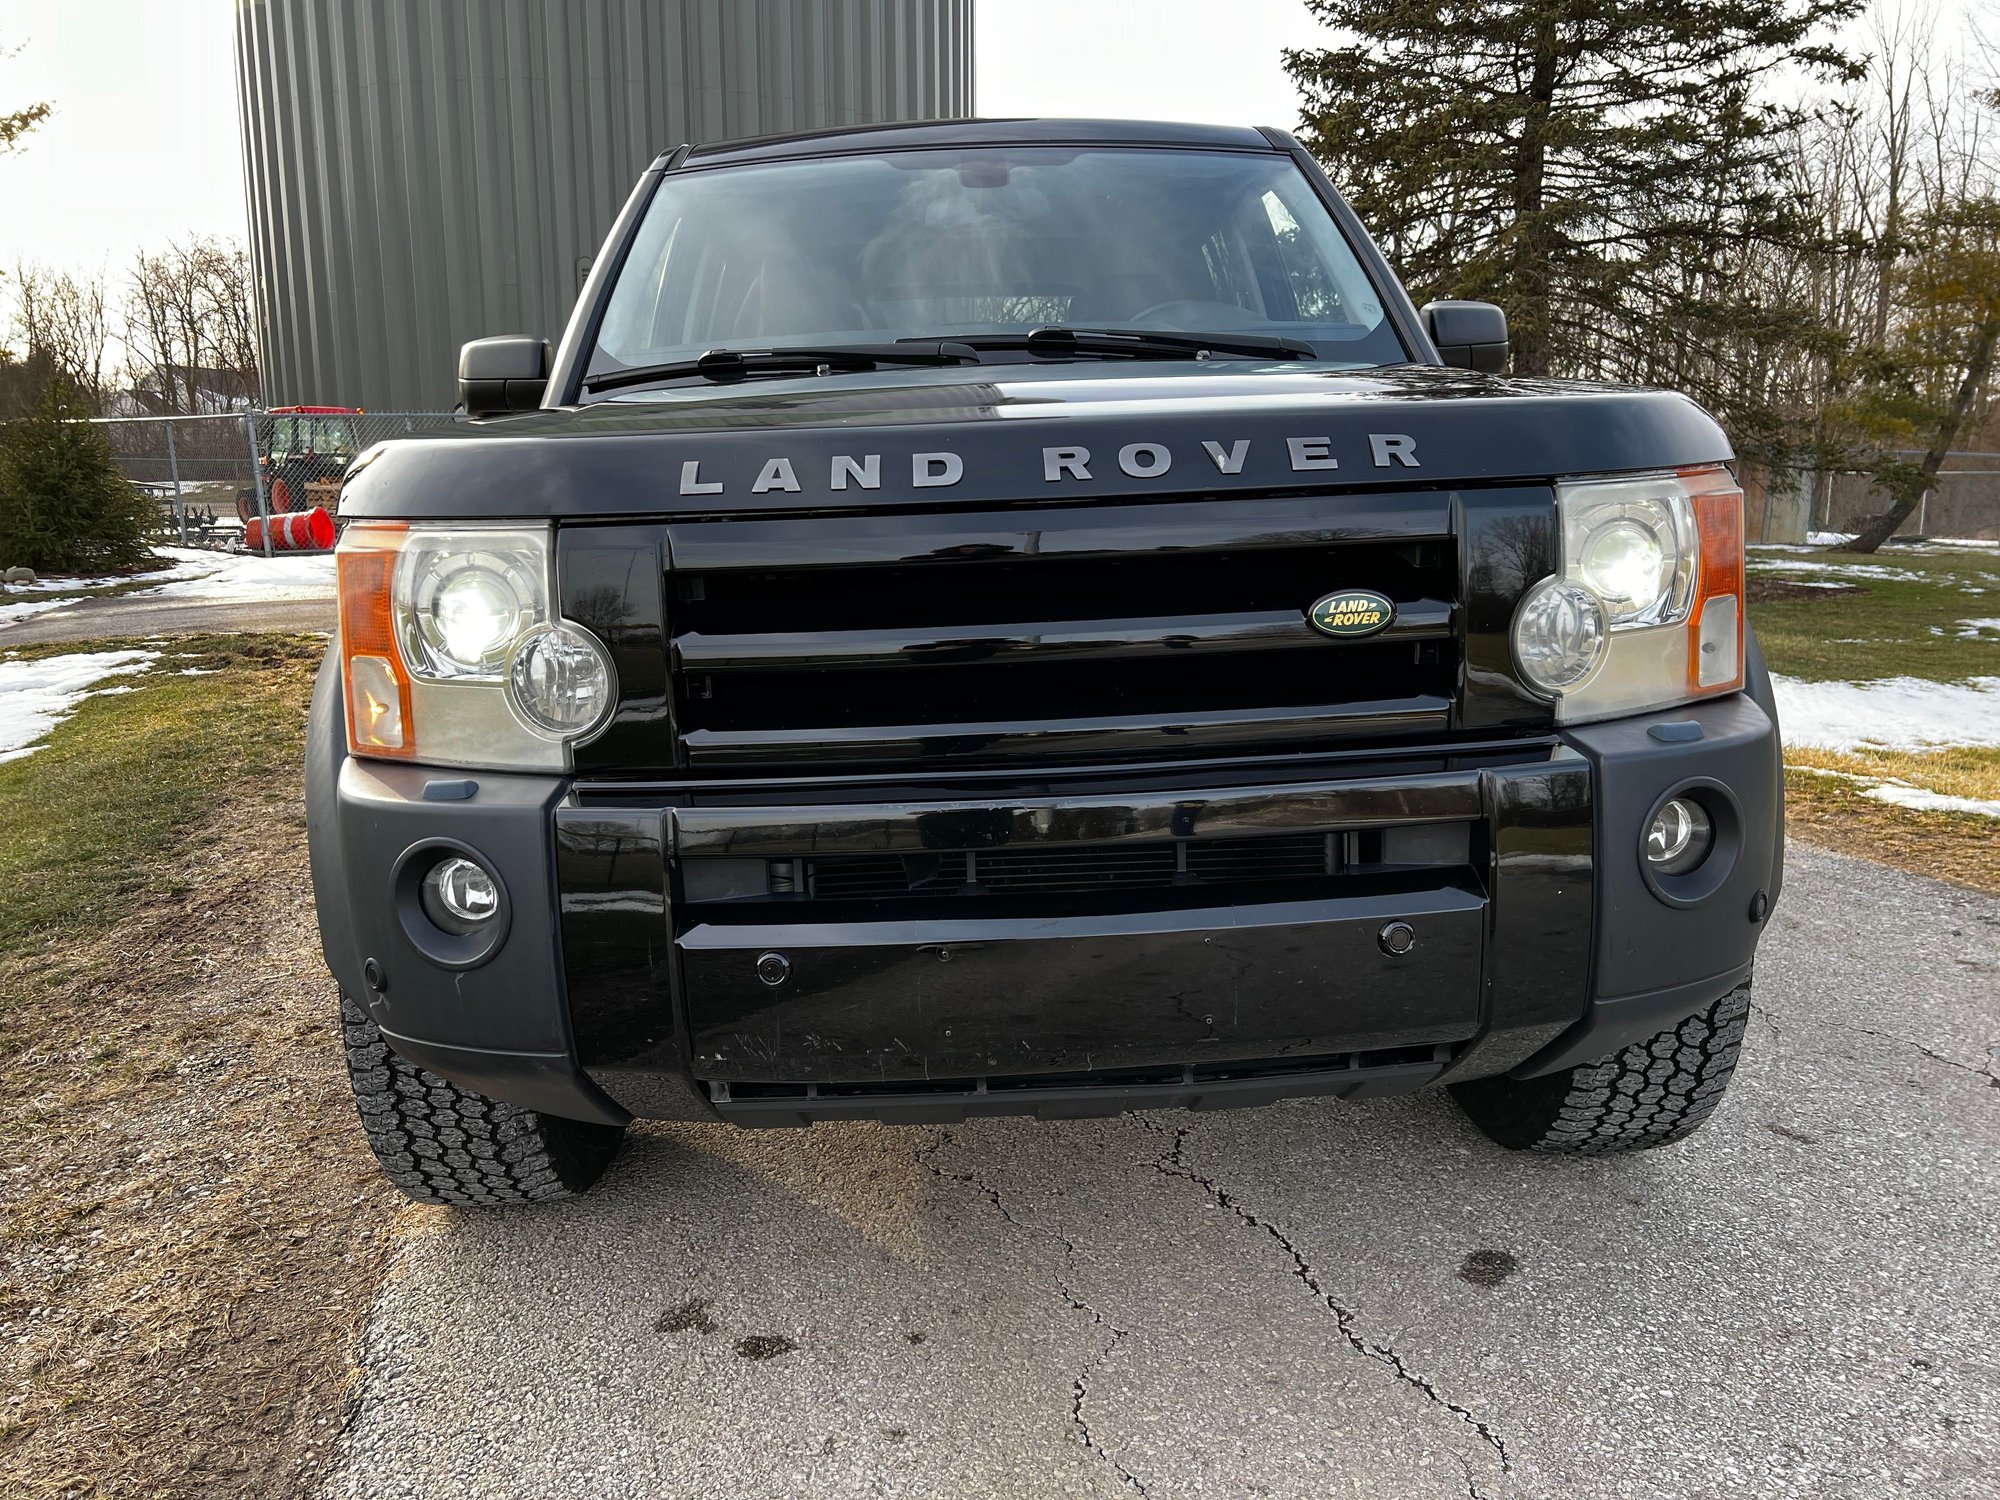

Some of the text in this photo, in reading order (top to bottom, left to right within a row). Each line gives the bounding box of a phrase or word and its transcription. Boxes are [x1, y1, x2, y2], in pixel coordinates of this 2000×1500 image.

[679, 433, 1421, 495] LAND ROVER
[1328, 599, 1369, 614] LAND
[1332, 611, 1381, 626] ROVER
